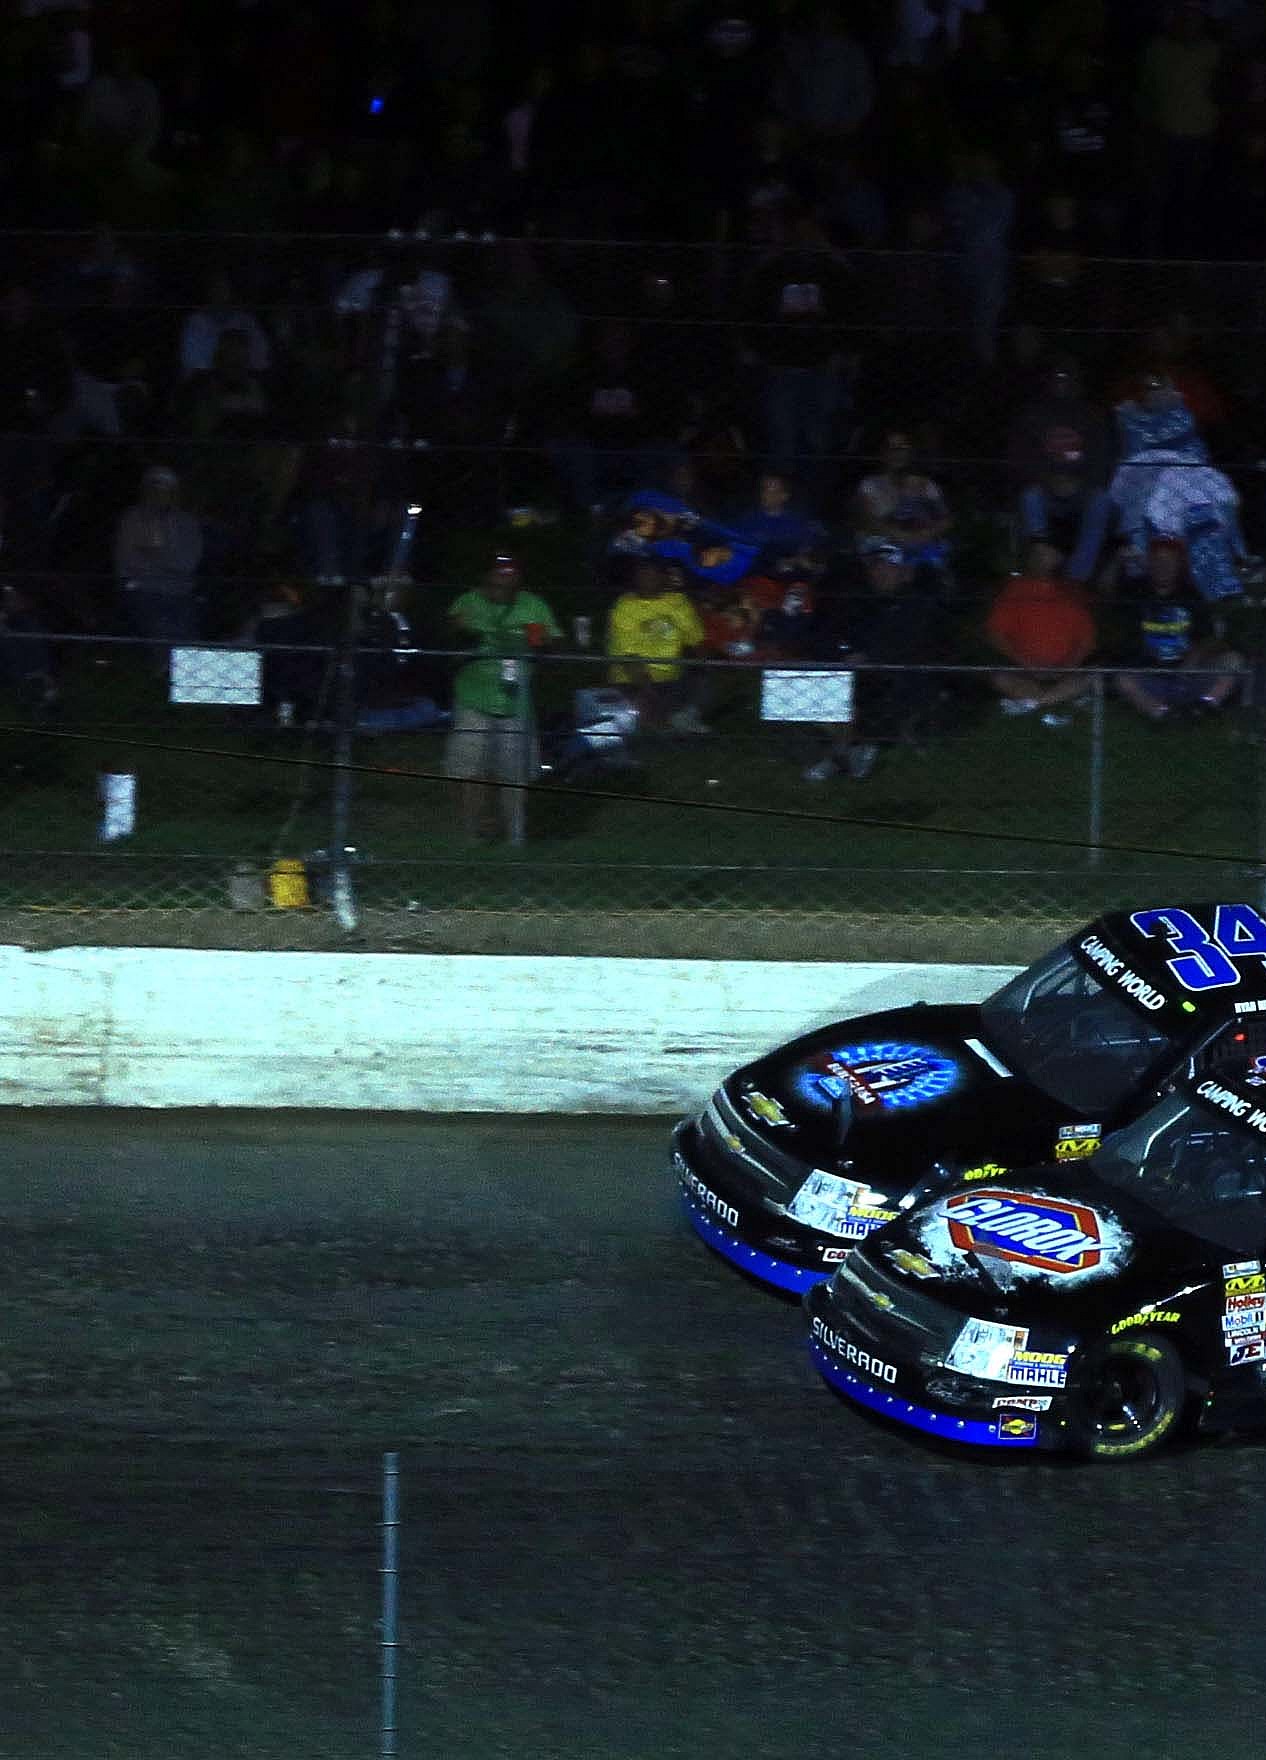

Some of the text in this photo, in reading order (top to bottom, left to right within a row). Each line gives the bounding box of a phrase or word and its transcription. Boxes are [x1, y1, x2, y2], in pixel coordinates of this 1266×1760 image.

[1079, 935, 1166, 1012] CAMPING WORLD
[1195, 1080, 1251, 1117] CAMPING
[936, 1199, 1117, 1263] CLOROX
[1228, 1296, 1265, 1308] Holley
[1111, 1311, 1181, 1335] GOODYEAR
[1225, 1313, 1253, 1326] Mobil
[811, 1316, 898, 1385] SILVERADO
[1015, 1351, 1068, 1365] MOOG
[1010, 1367, 1066, 1385] MAHLE
